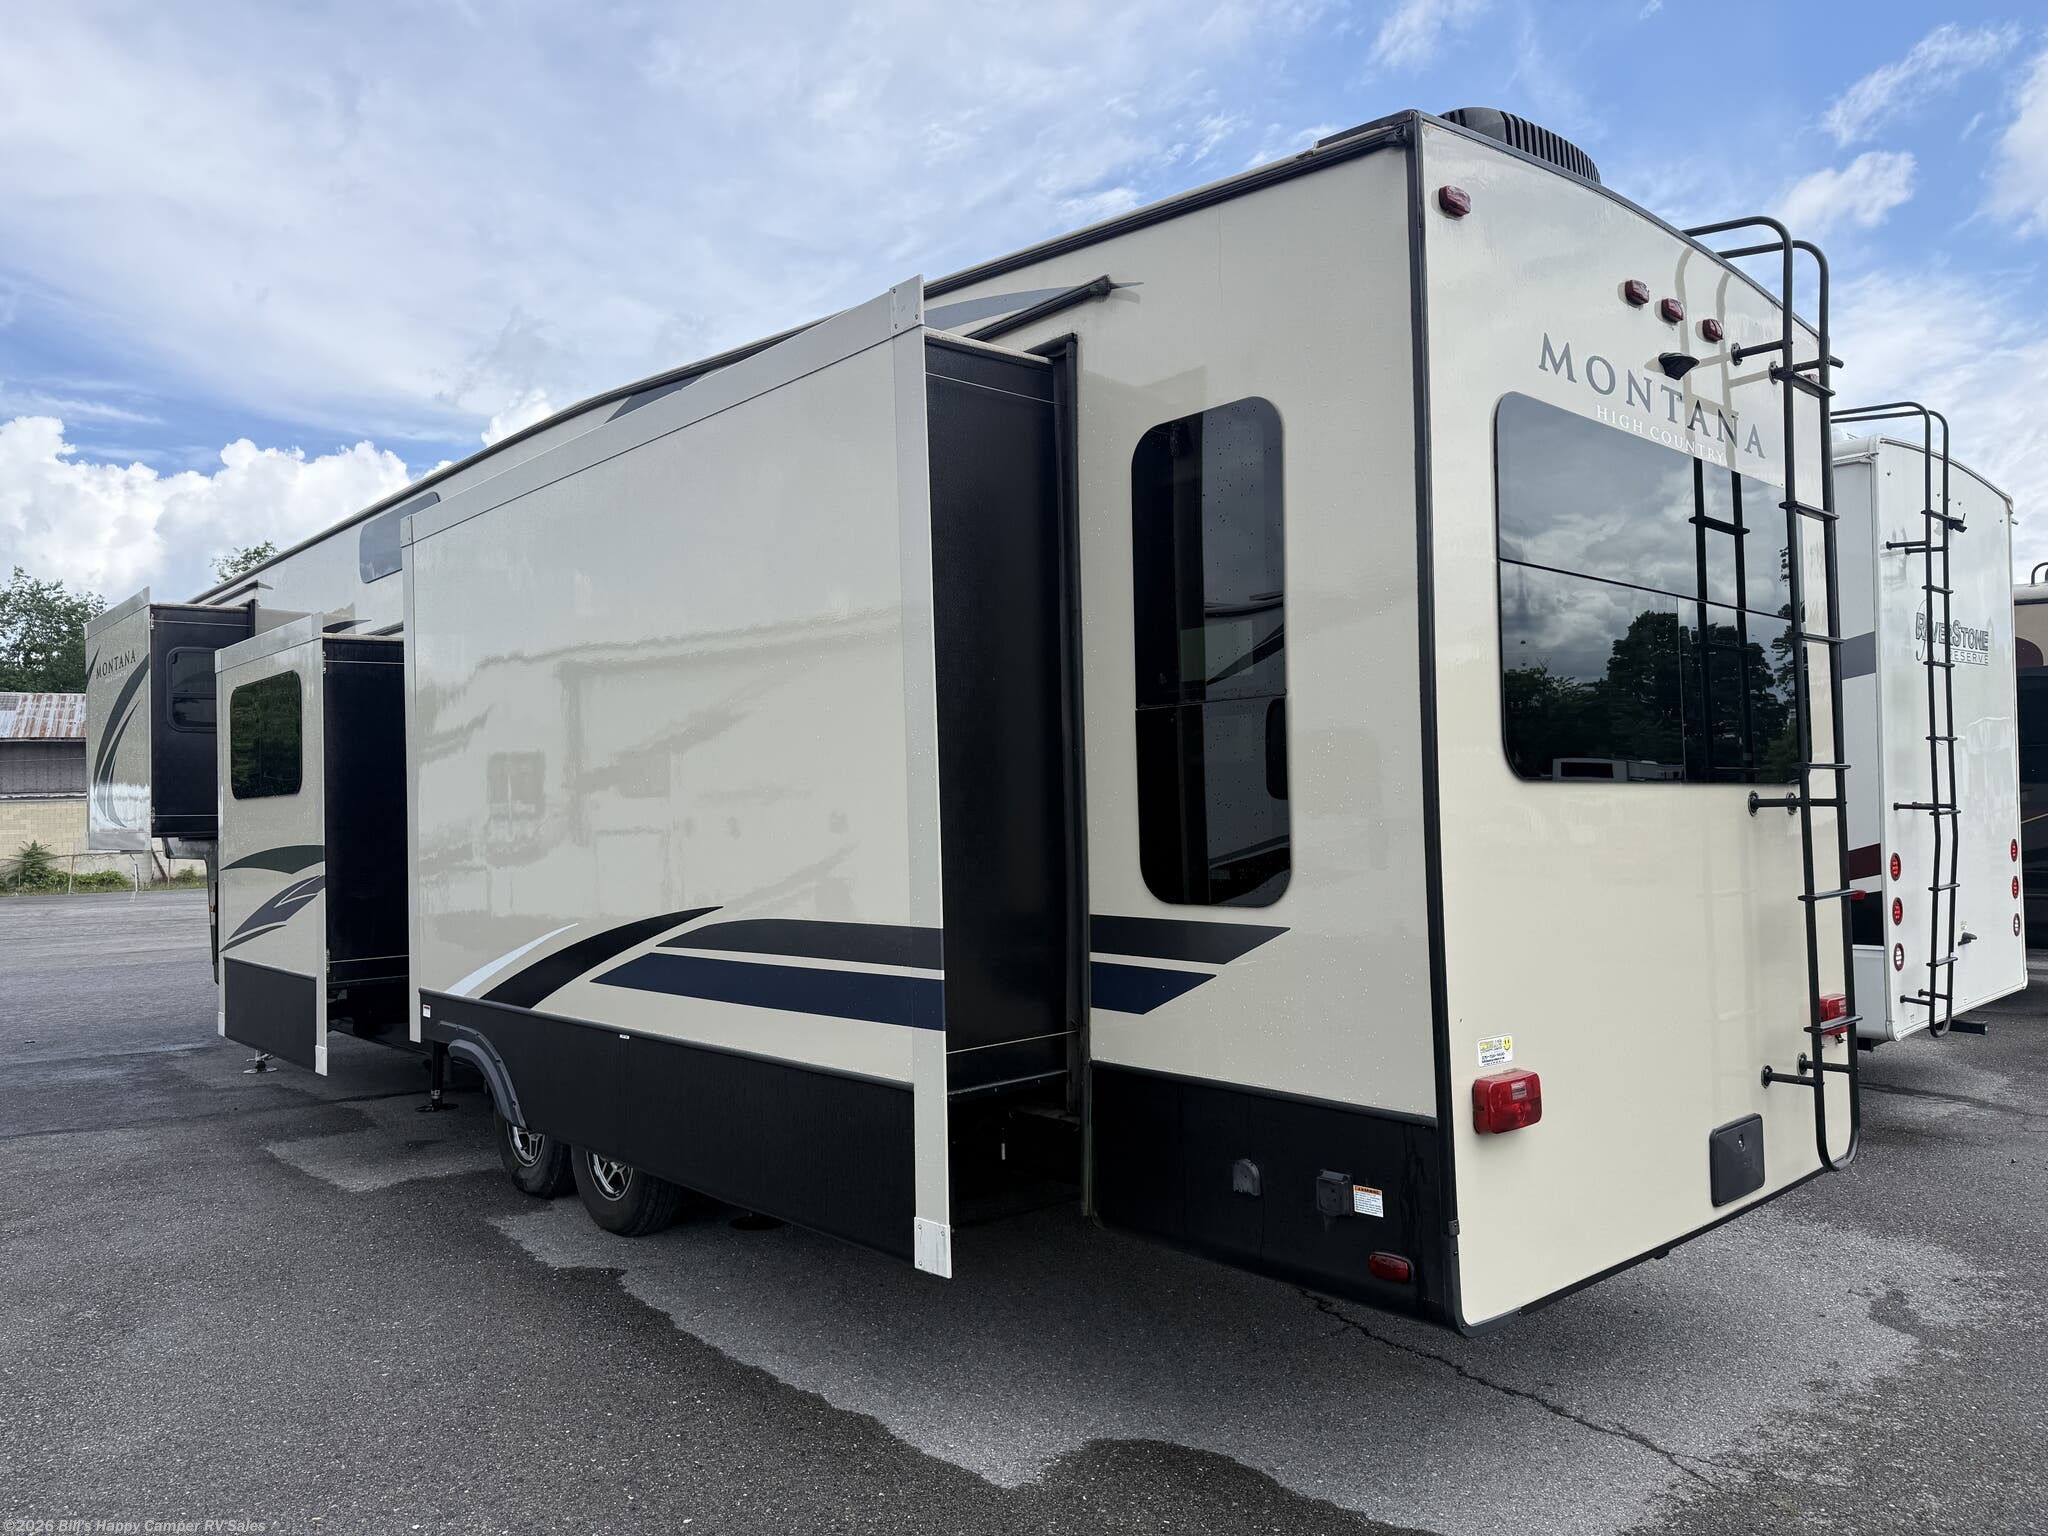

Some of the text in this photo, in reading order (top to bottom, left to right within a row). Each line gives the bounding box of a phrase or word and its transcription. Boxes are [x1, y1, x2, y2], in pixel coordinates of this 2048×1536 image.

[1538, 332, 1766, 459] MONTANA
[1597, 405, 1726, 463] HIGH COUNTRY
[95, 647, 137, 680] MONTANA
[1949, 649, 1989, 665] ESERVE
